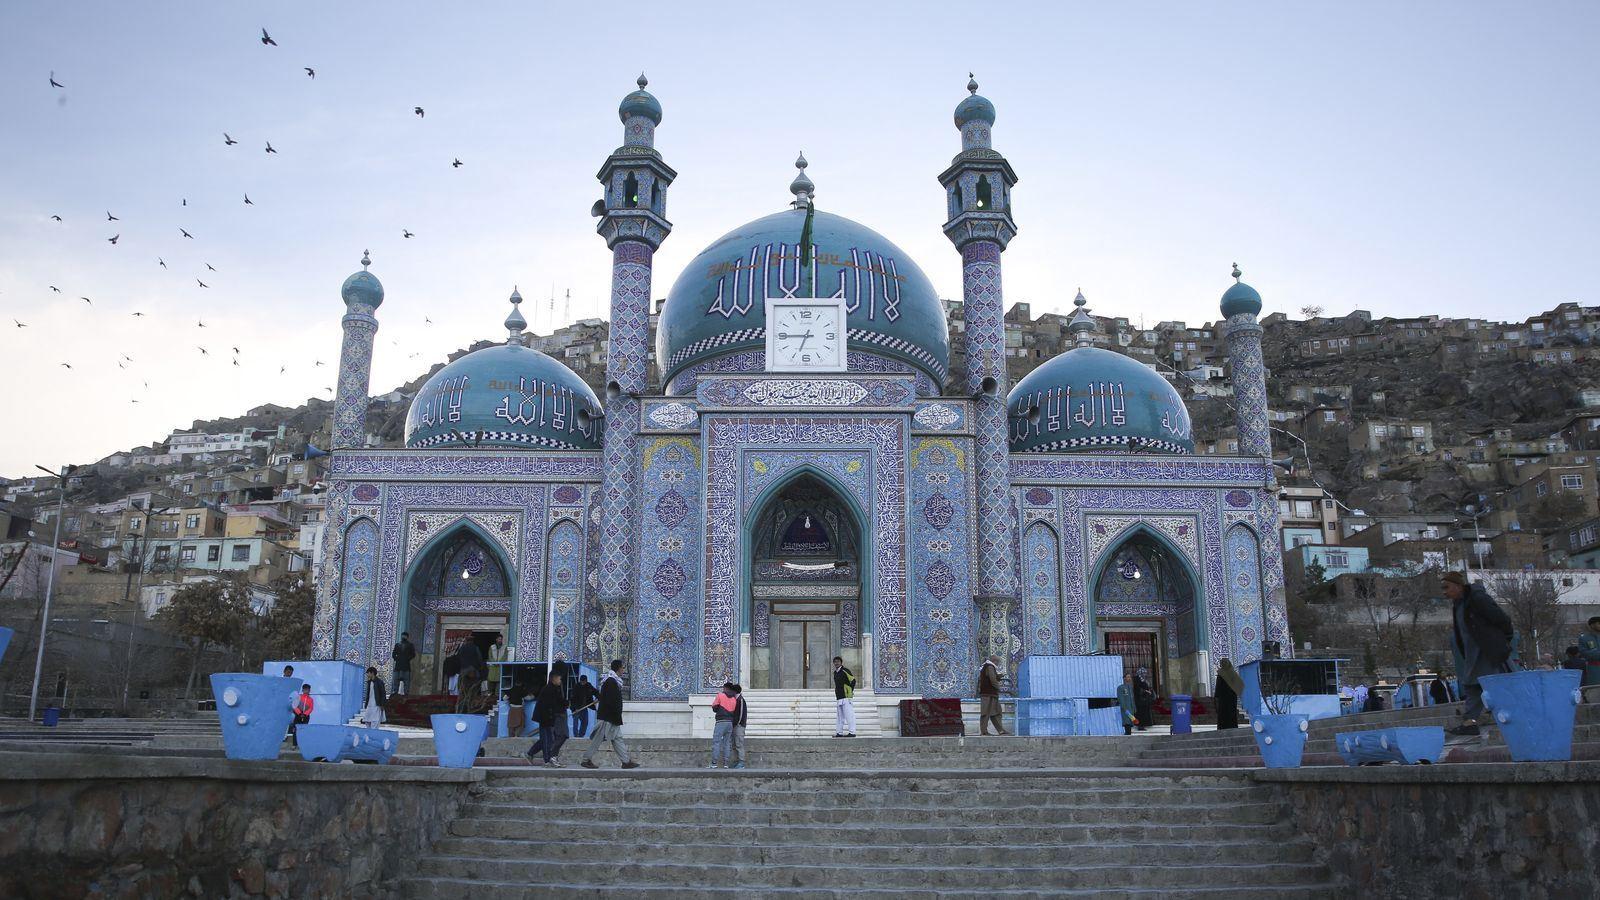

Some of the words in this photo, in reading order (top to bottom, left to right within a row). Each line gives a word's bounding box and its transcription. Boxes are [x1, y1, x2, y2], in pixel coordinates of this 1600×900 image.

[799, 311, 812, 319] 12
[778, 332, 788, 340] 9
[825, 332, 835, 341] 3
[801, 354, 811, 362] 6
